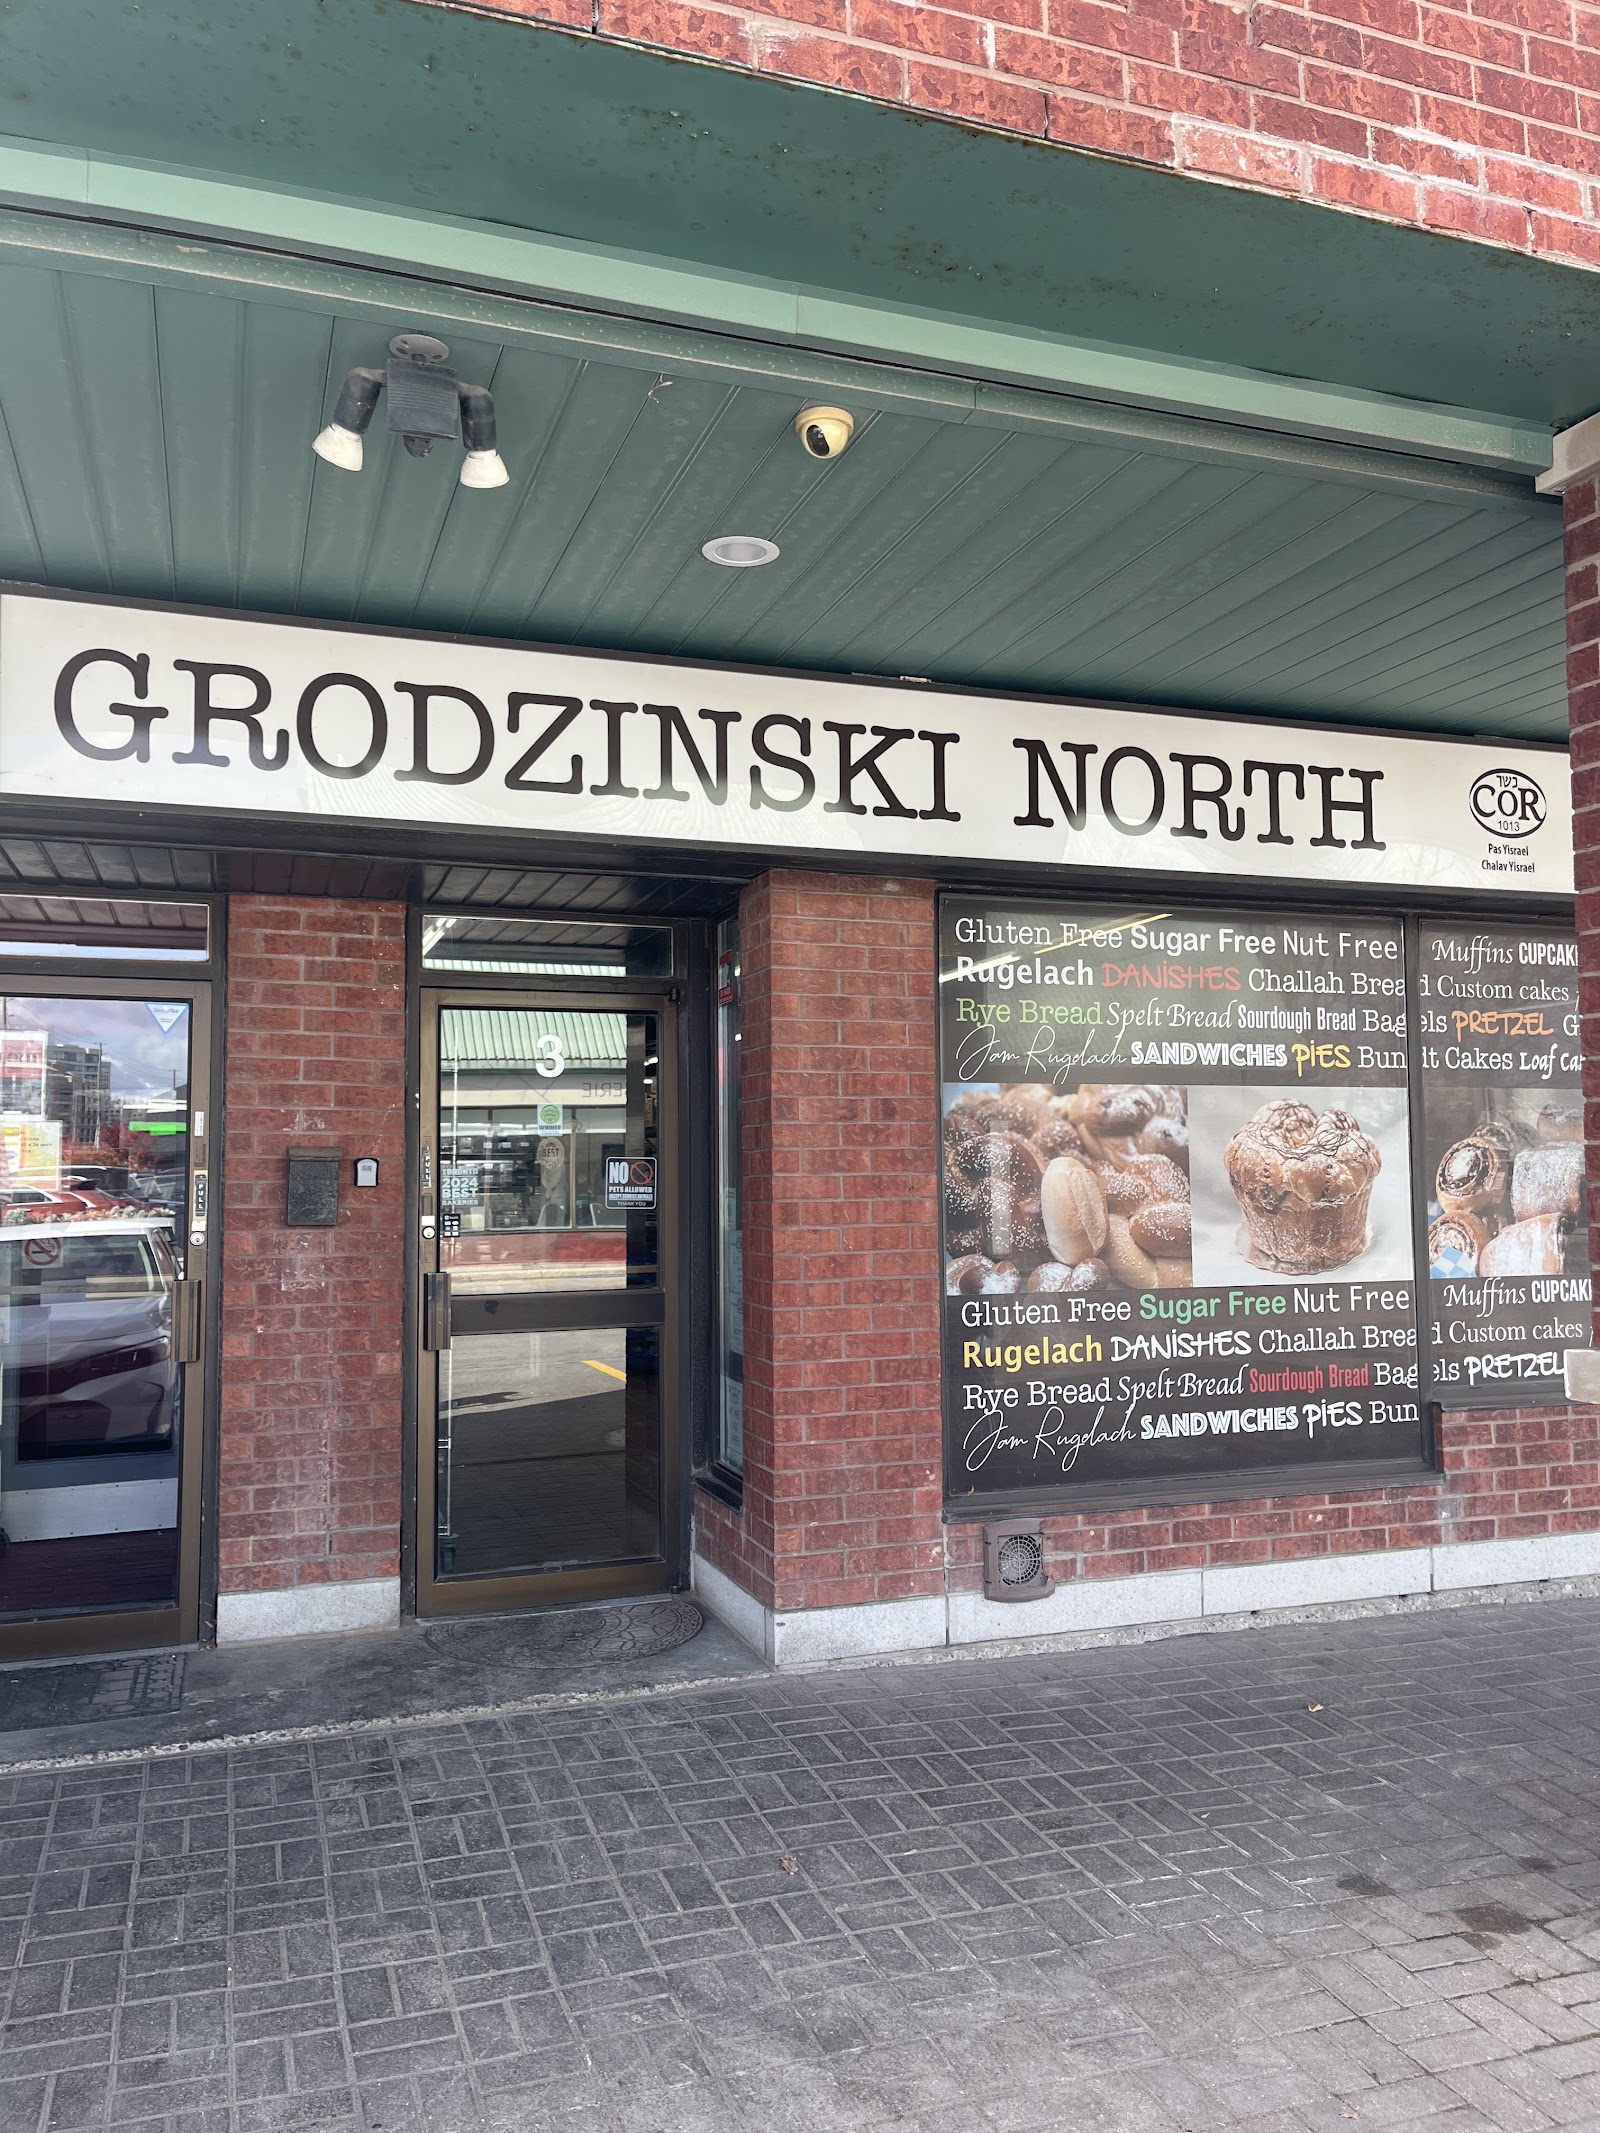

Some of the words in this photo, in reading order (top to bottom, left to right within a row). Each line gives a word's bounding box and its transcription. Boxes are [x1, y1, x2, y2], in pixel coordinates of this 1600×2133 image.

[53, 648, 961, 823] GRODZINSKI
[1012, 737, 1387, 852] NORTH
[1496, 775, 1518, 788] כשר
[1472, 784, 1544, 822] COR
[1498, 820, 1520, 832] 1013
[1481, 859, 1508, 871] Chalav
[1509, 861, 1535, 873] Yisrael
[1488, 843, 1502, 854] Pas
[1503, 844, 1529, 857] Yisrael
[955, 917, 1053, 946] Gluten
[1059, 922, 1123, 949] Free
[1130, 925, 1211, 957] Sugar
[1219, 928, 1277, 955] Free
[1283, 930, 1330, 957] Nut
[1339, 932, 1398, 960] Free
[1431, 935, 1514, 975] Muffins
[956, 955, 1094, 990] Rugelach
[1248, 968, 1346, 994] Challah
[1351, 971, 1406, 997] Brea
[1437, 974, 1514, 1000] Custom
[1519, 978, 1570, 1001] cakes
[955, 997, 1012, 1028] Rye
[1018, 1000, 1104, 1026] Bread
[1105, 997, 1165, 1037] Spelt
[1168, 999, 1238, 1029] Bread
[1237, 1004, 1312, 1034] Sourdough
[1316, 1006, 1357, 1032] Bread
[1362, 1009, 1407, 1038] Bag
[1451, 1009, 1554, 1043] PRETZEL
[535, 1033, 565, 1079] 3
[955, 1024, 1020, 1082] Jam
[1024, 1025, 1127, 1085] Rugelach
[1130, 1041, 1288, 1068] SANDWICHES
[1357, 1046, 1408, 1069] Bun
[1445, 1046, 1513, 1071] Cakes
[1518, 1042, 1558, 1080] Loaf
[542, 1148, 560, 1157] BEST
[442, 1168, 479, 1176] TORONTO
[442, 1177, 479, 1188] 2024
[609, 1161, 630, 1185] NO
[624, 1186, 653, 1194] ALLOWED
[442, 1187, 479, 1198] BEST
[961, 1300, 1061, 1327] Gluten
[1067, 1297, 1132, 1323] Free
[1139, 1293, 1222, 1325] Sugar
[1228, 1291, 1287, 1316] Free
[1293, 1286, 1341, 1314] Nut
[1349, 1285, 1410, 1312] Free
[1442, 1277, 1527, 1318] Muffins
[1448, 1320, 1527, 1344] Custom
[1532, 1316, 1584, 1340] cakes
[962, 1334, 1103, 1373] Rugelach
[1258, 1327, 1357, 1355] Challah
[1361, 1325, 1417, 1348] Brea
[1463, 1350, 1565, 1386] PRETZEL
[962, 1384, 1019, 1414] Rye
[1026, 1377, 1113, 1407] Bread
[1116, 1367, 1176, 1412] Spelt
[1177, 1363, 1250, 1398] Bread
[1249, 1365, 1325, 1394] Sourdough
[1328, 1362, 1370, 1388] Bread
[1374, 1362, 1419, 1389] Bag
[962, 1409, 1029, 1472] Jam
[1032, 1406, 1137, 1472] Rugelach
[1140, 1405, 1300, 1440] SANDWICHES
[1368, 1400, 1420, 1426] Bun
